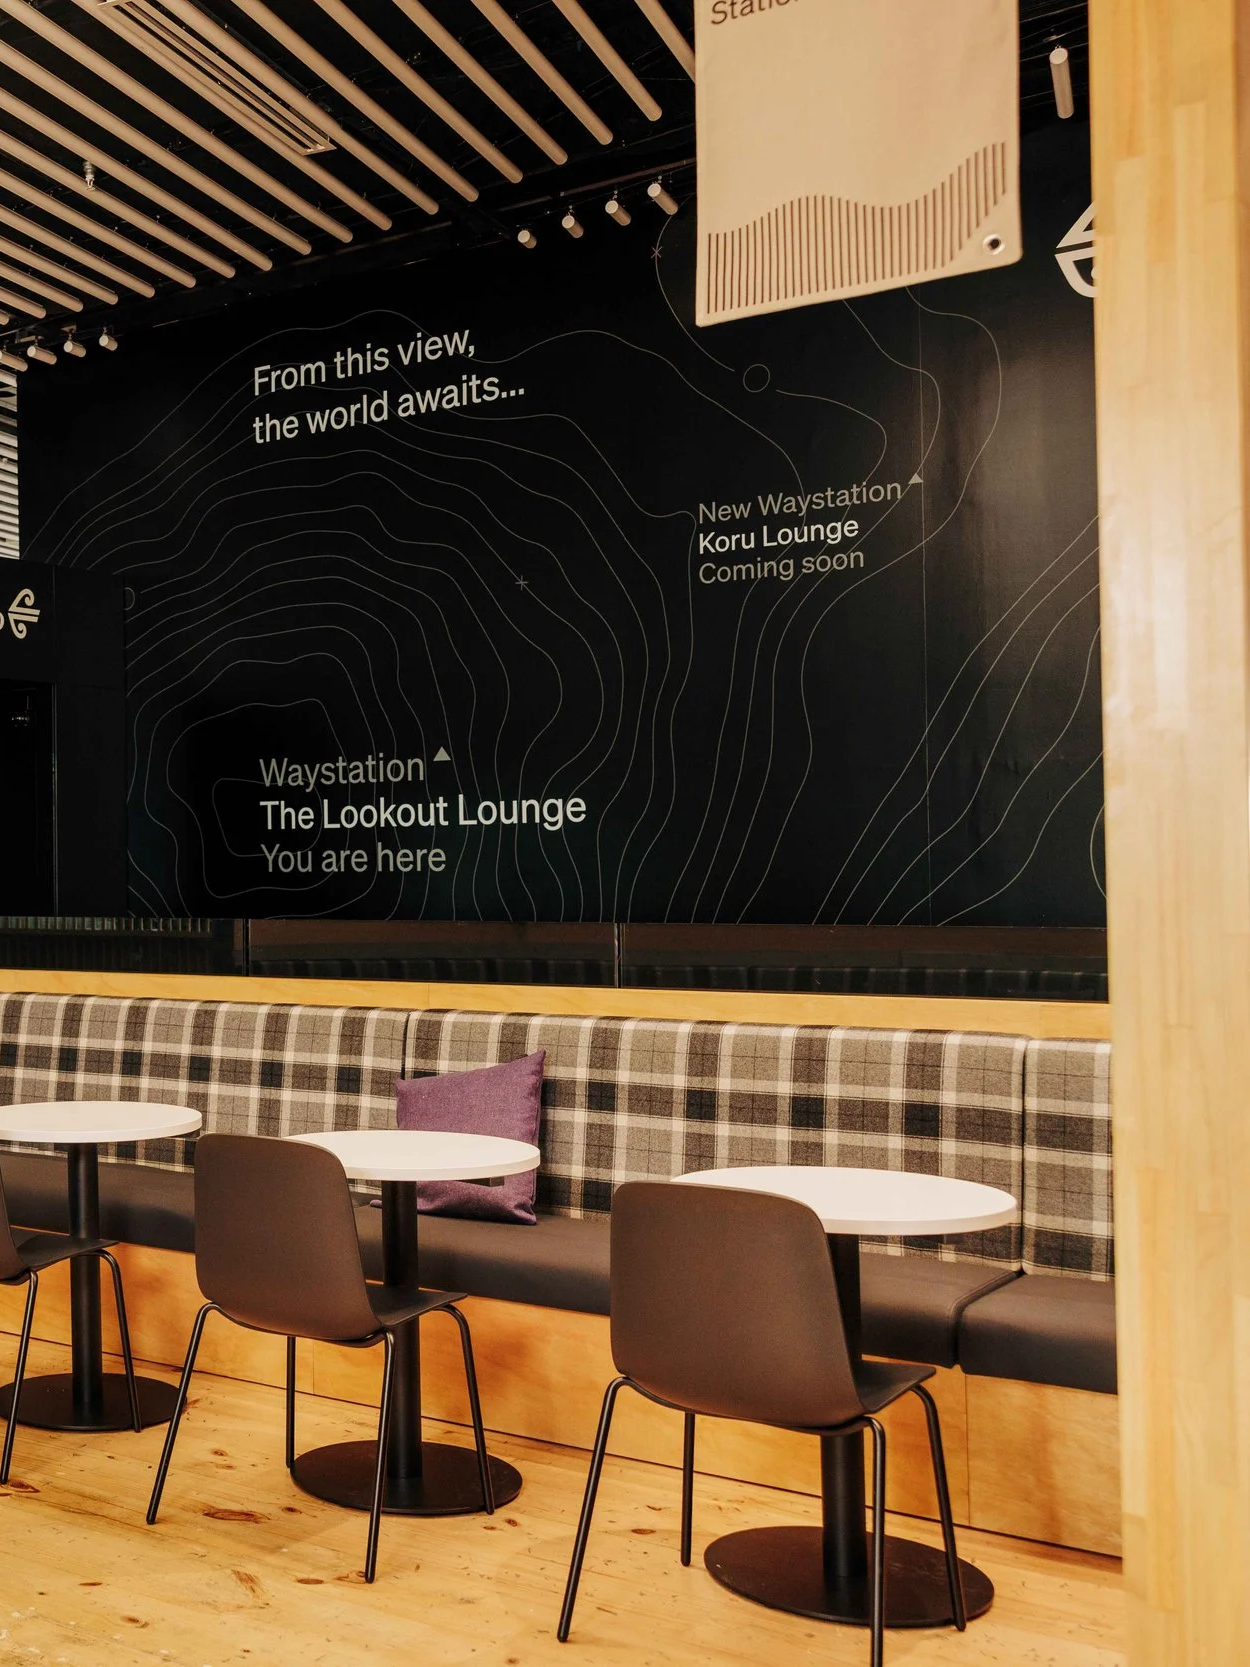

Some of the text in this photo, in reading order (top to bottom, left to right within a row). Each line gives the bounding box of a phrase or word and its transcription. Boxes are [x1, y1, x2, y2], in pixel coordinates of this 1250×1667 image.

[254, 329, 475, 396] From this view,
[253, 374, 526, 444] the world awaits...
[699, 481, 902, 524] New Waystation
[699, 519, 859, 554] Koru Lounge
[699, 550, 865, 585] Coming soon
[259, 752, 425, 793] Waystation
[259, 794, 587, 831] The Lookout Lounge
[260, 842, 447, 873] You are here
